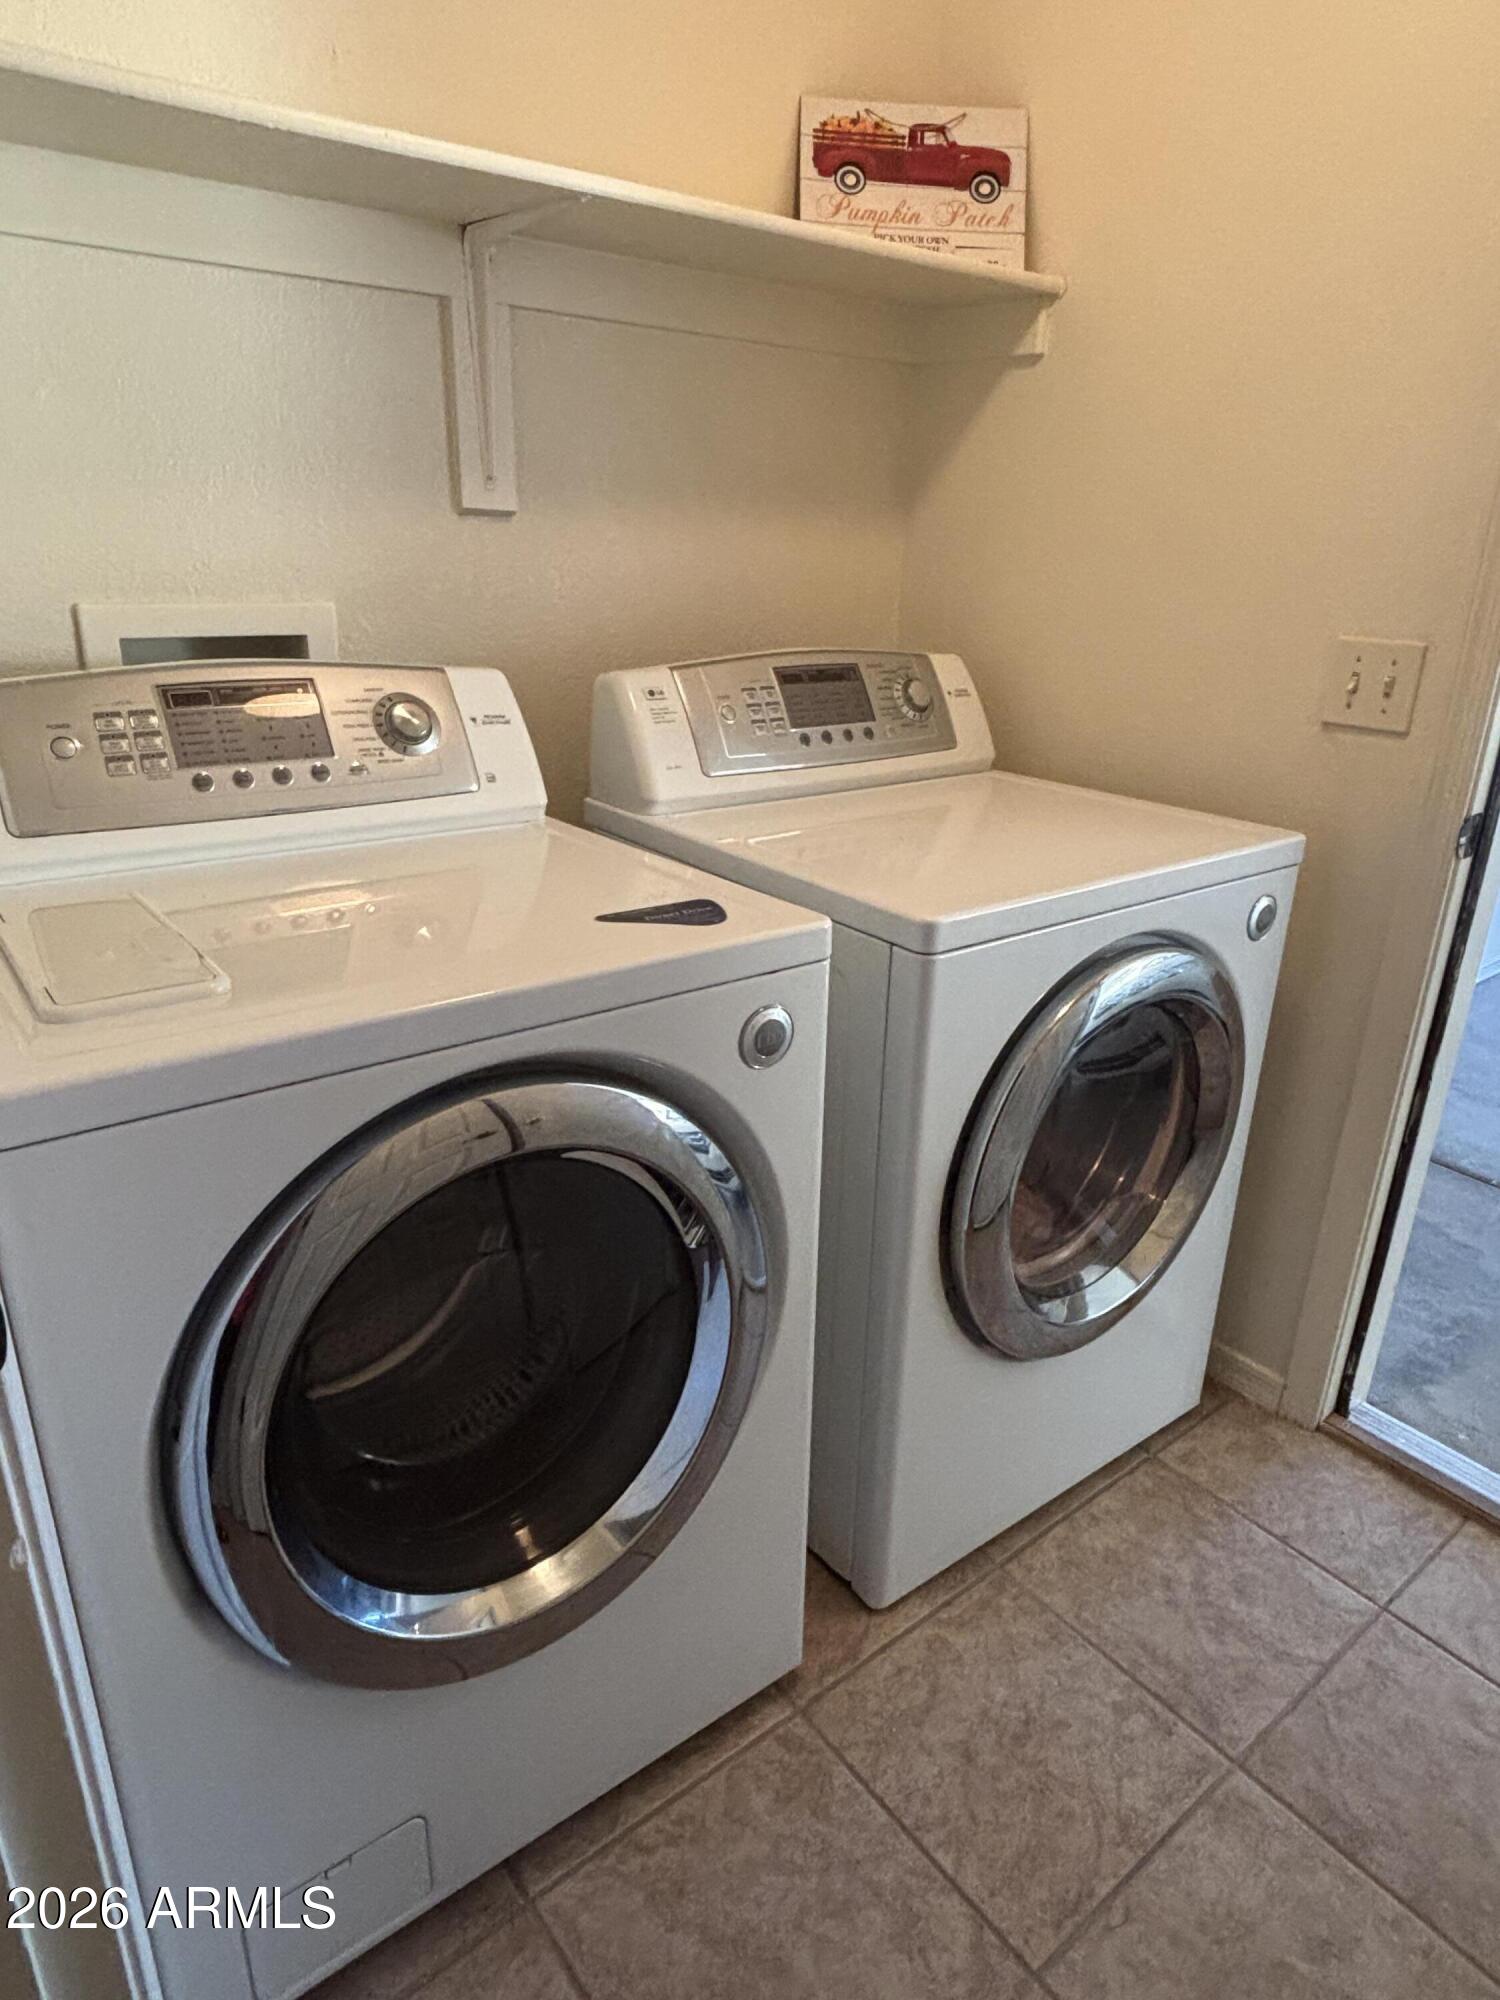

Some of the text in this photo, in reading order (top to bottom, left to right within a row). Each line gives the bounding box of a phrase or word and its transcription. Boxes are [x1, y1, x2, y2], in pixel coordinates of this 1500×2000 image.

[816, 193, 1015, 233] Pumpkin Patch
[926, 236, 950, 245] OWN
